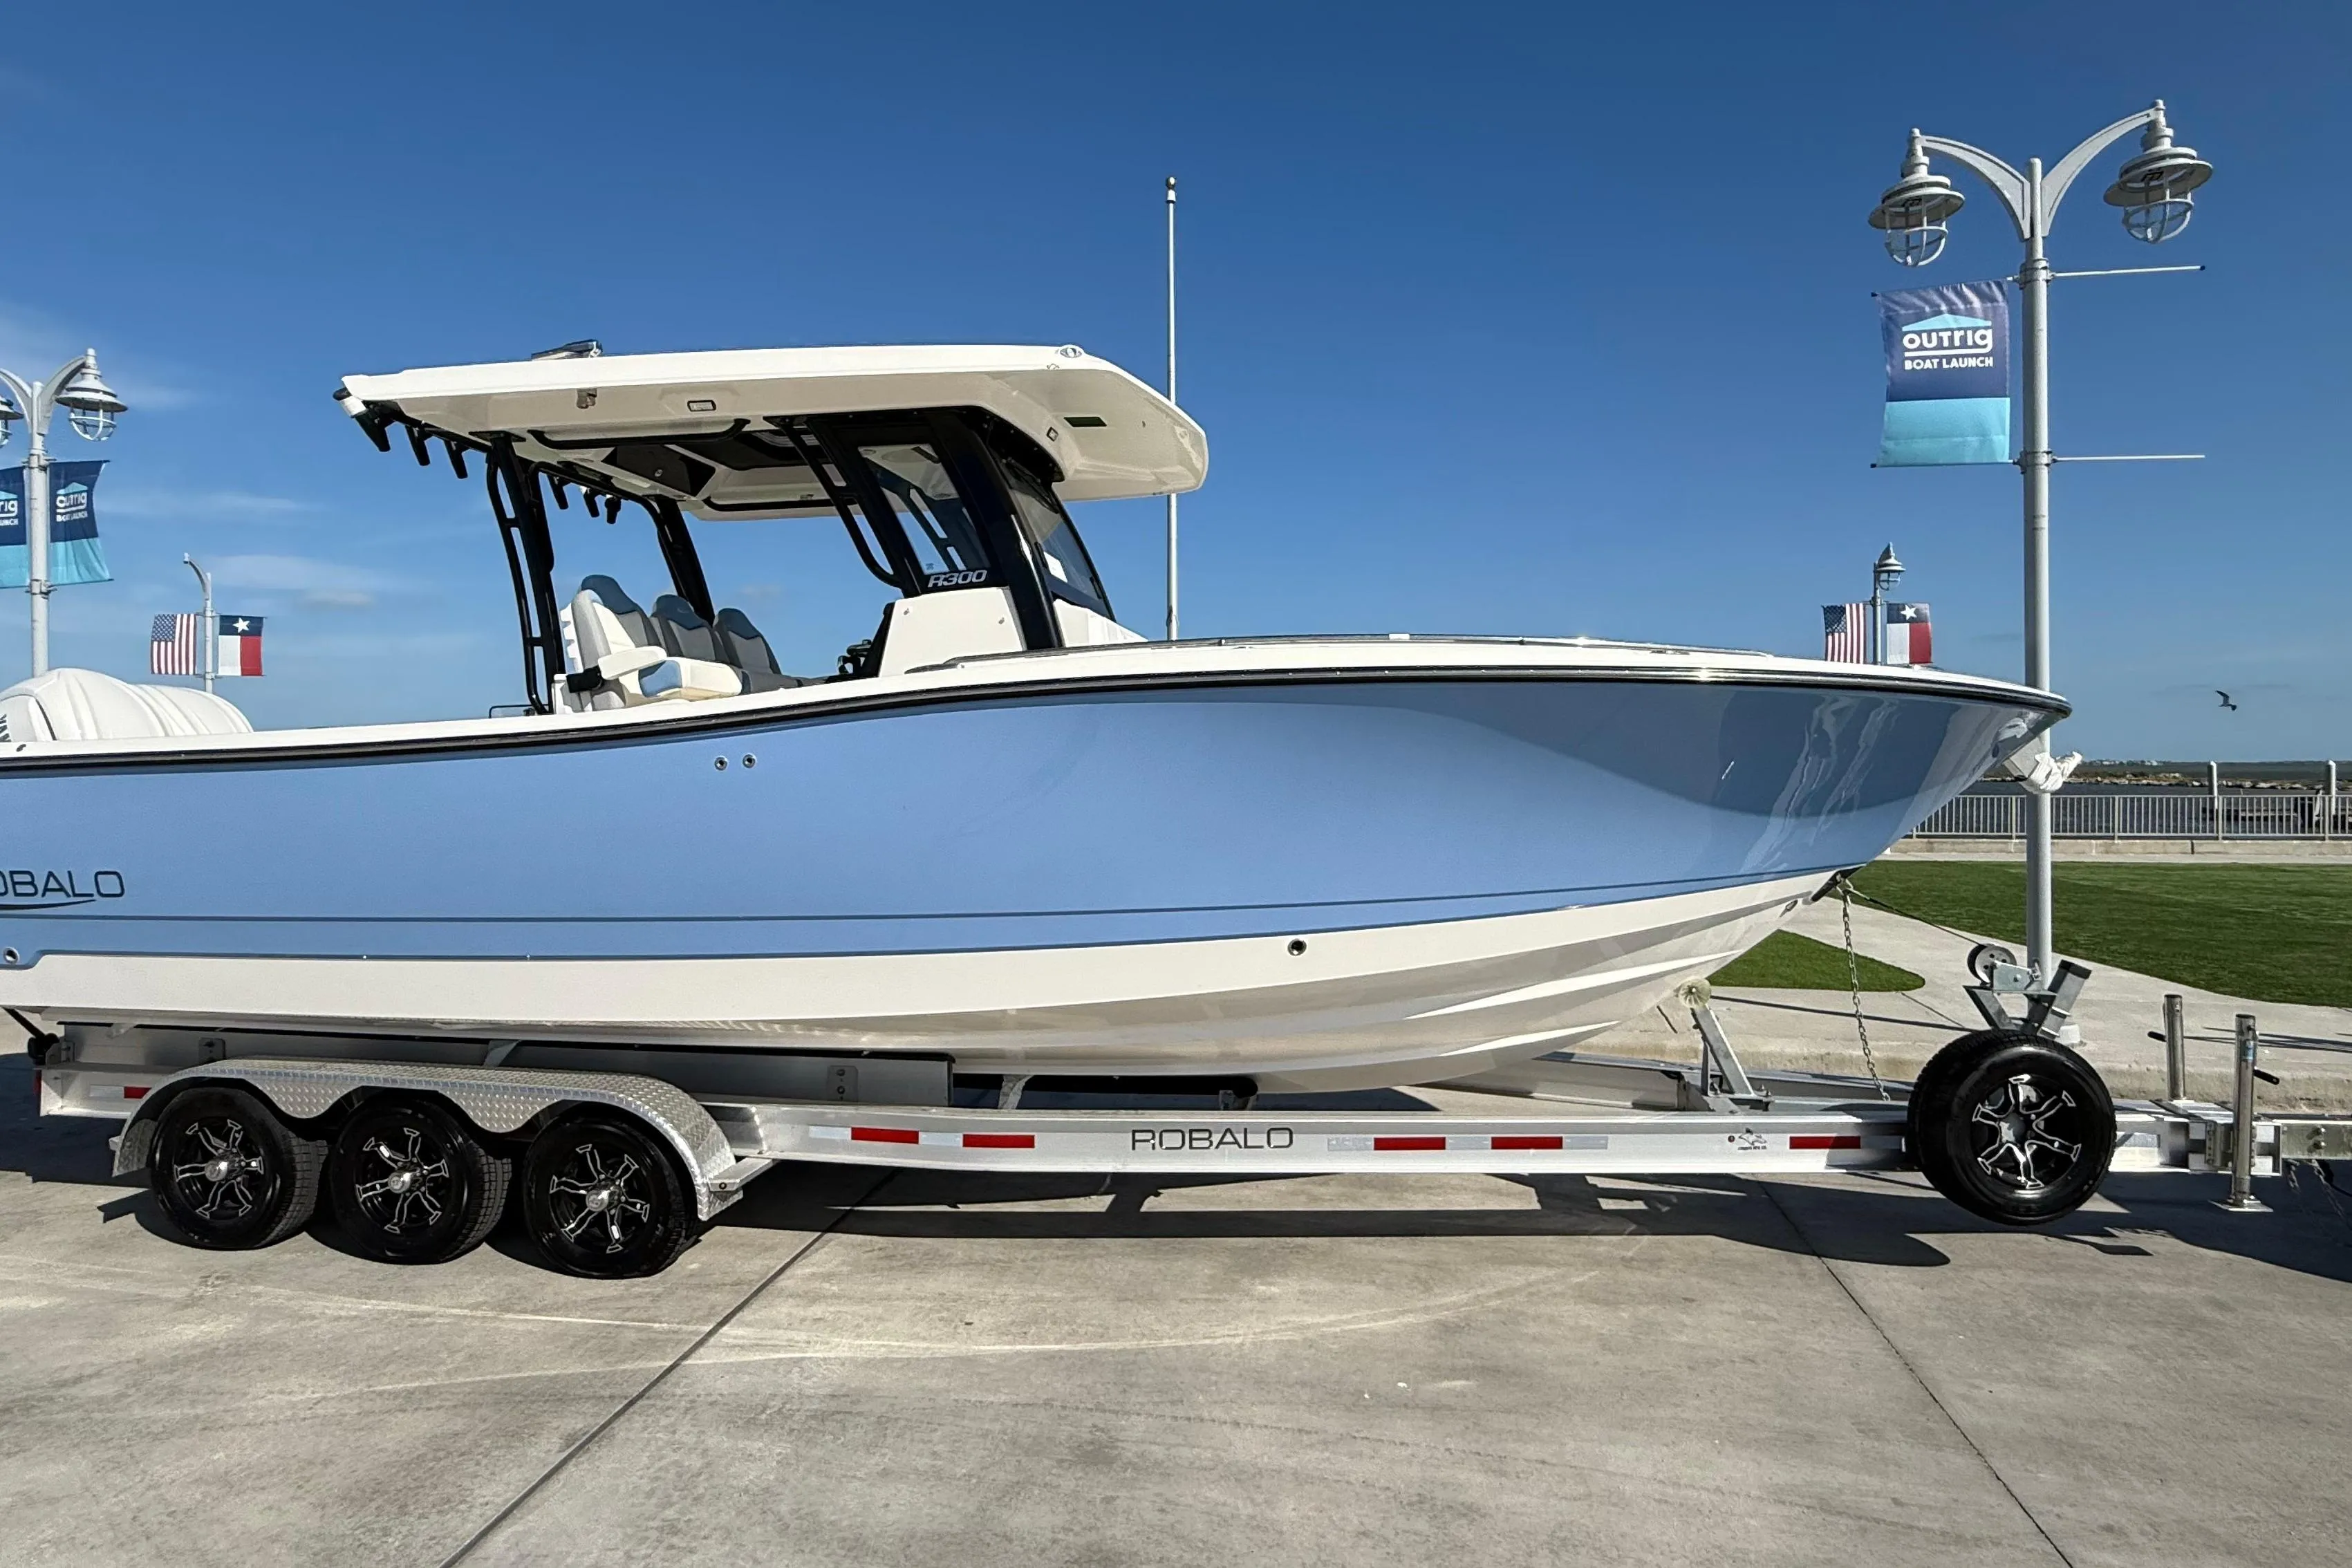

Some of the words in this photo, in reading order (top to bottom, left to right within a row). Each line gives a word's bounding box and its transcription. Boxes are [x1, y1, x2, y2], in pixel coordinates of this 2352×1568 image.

[1904, 358, 1939, 370] BOAT
[1942, 356, 1993, 368] LAUNCH
[927, 569, 988, 588] R300
[1132, 1128, 1294, 1150] ROBALO
